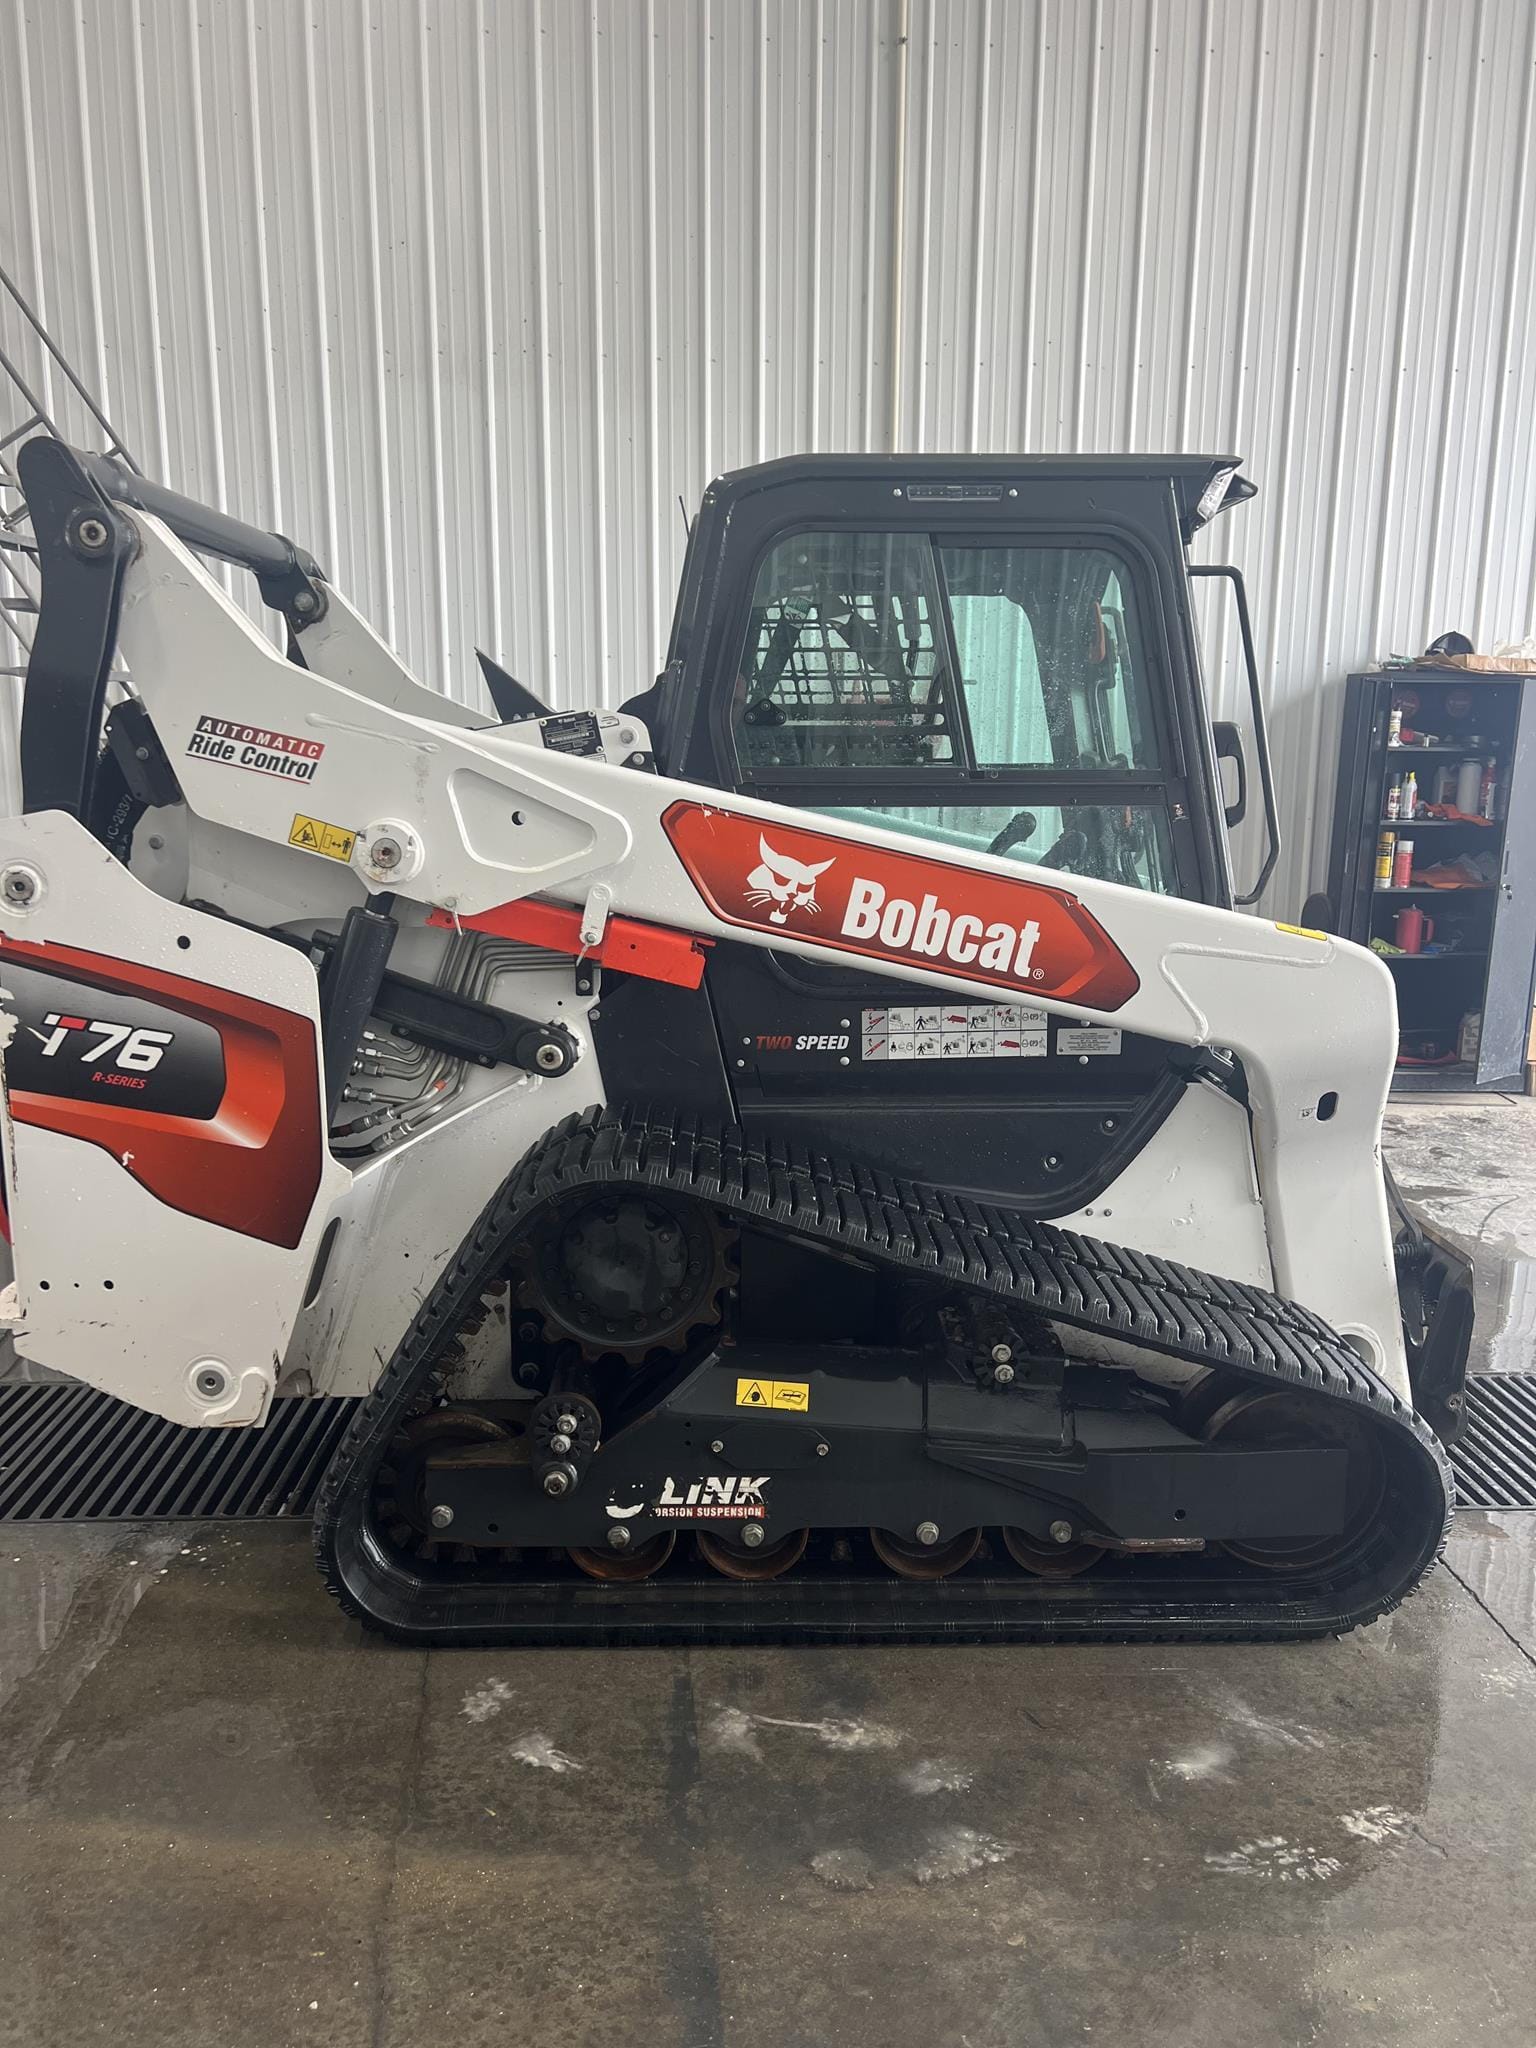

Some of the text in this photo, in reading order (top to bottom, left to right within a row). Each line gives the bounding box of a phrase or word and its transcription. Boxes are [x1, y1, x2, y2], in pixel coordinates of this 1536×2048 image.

[200, 719, 320, 757] AUTOMATIC
[187, 732, 319, 780] Ride Control
[41, 1013, 175, 1073] T76
[755, 1034, 850, 1051] TWO SPEED
[91, 1071, 148, 1090] R-SERIES
[650, 1506, 763, 1519] ORSION SUSPENSION
